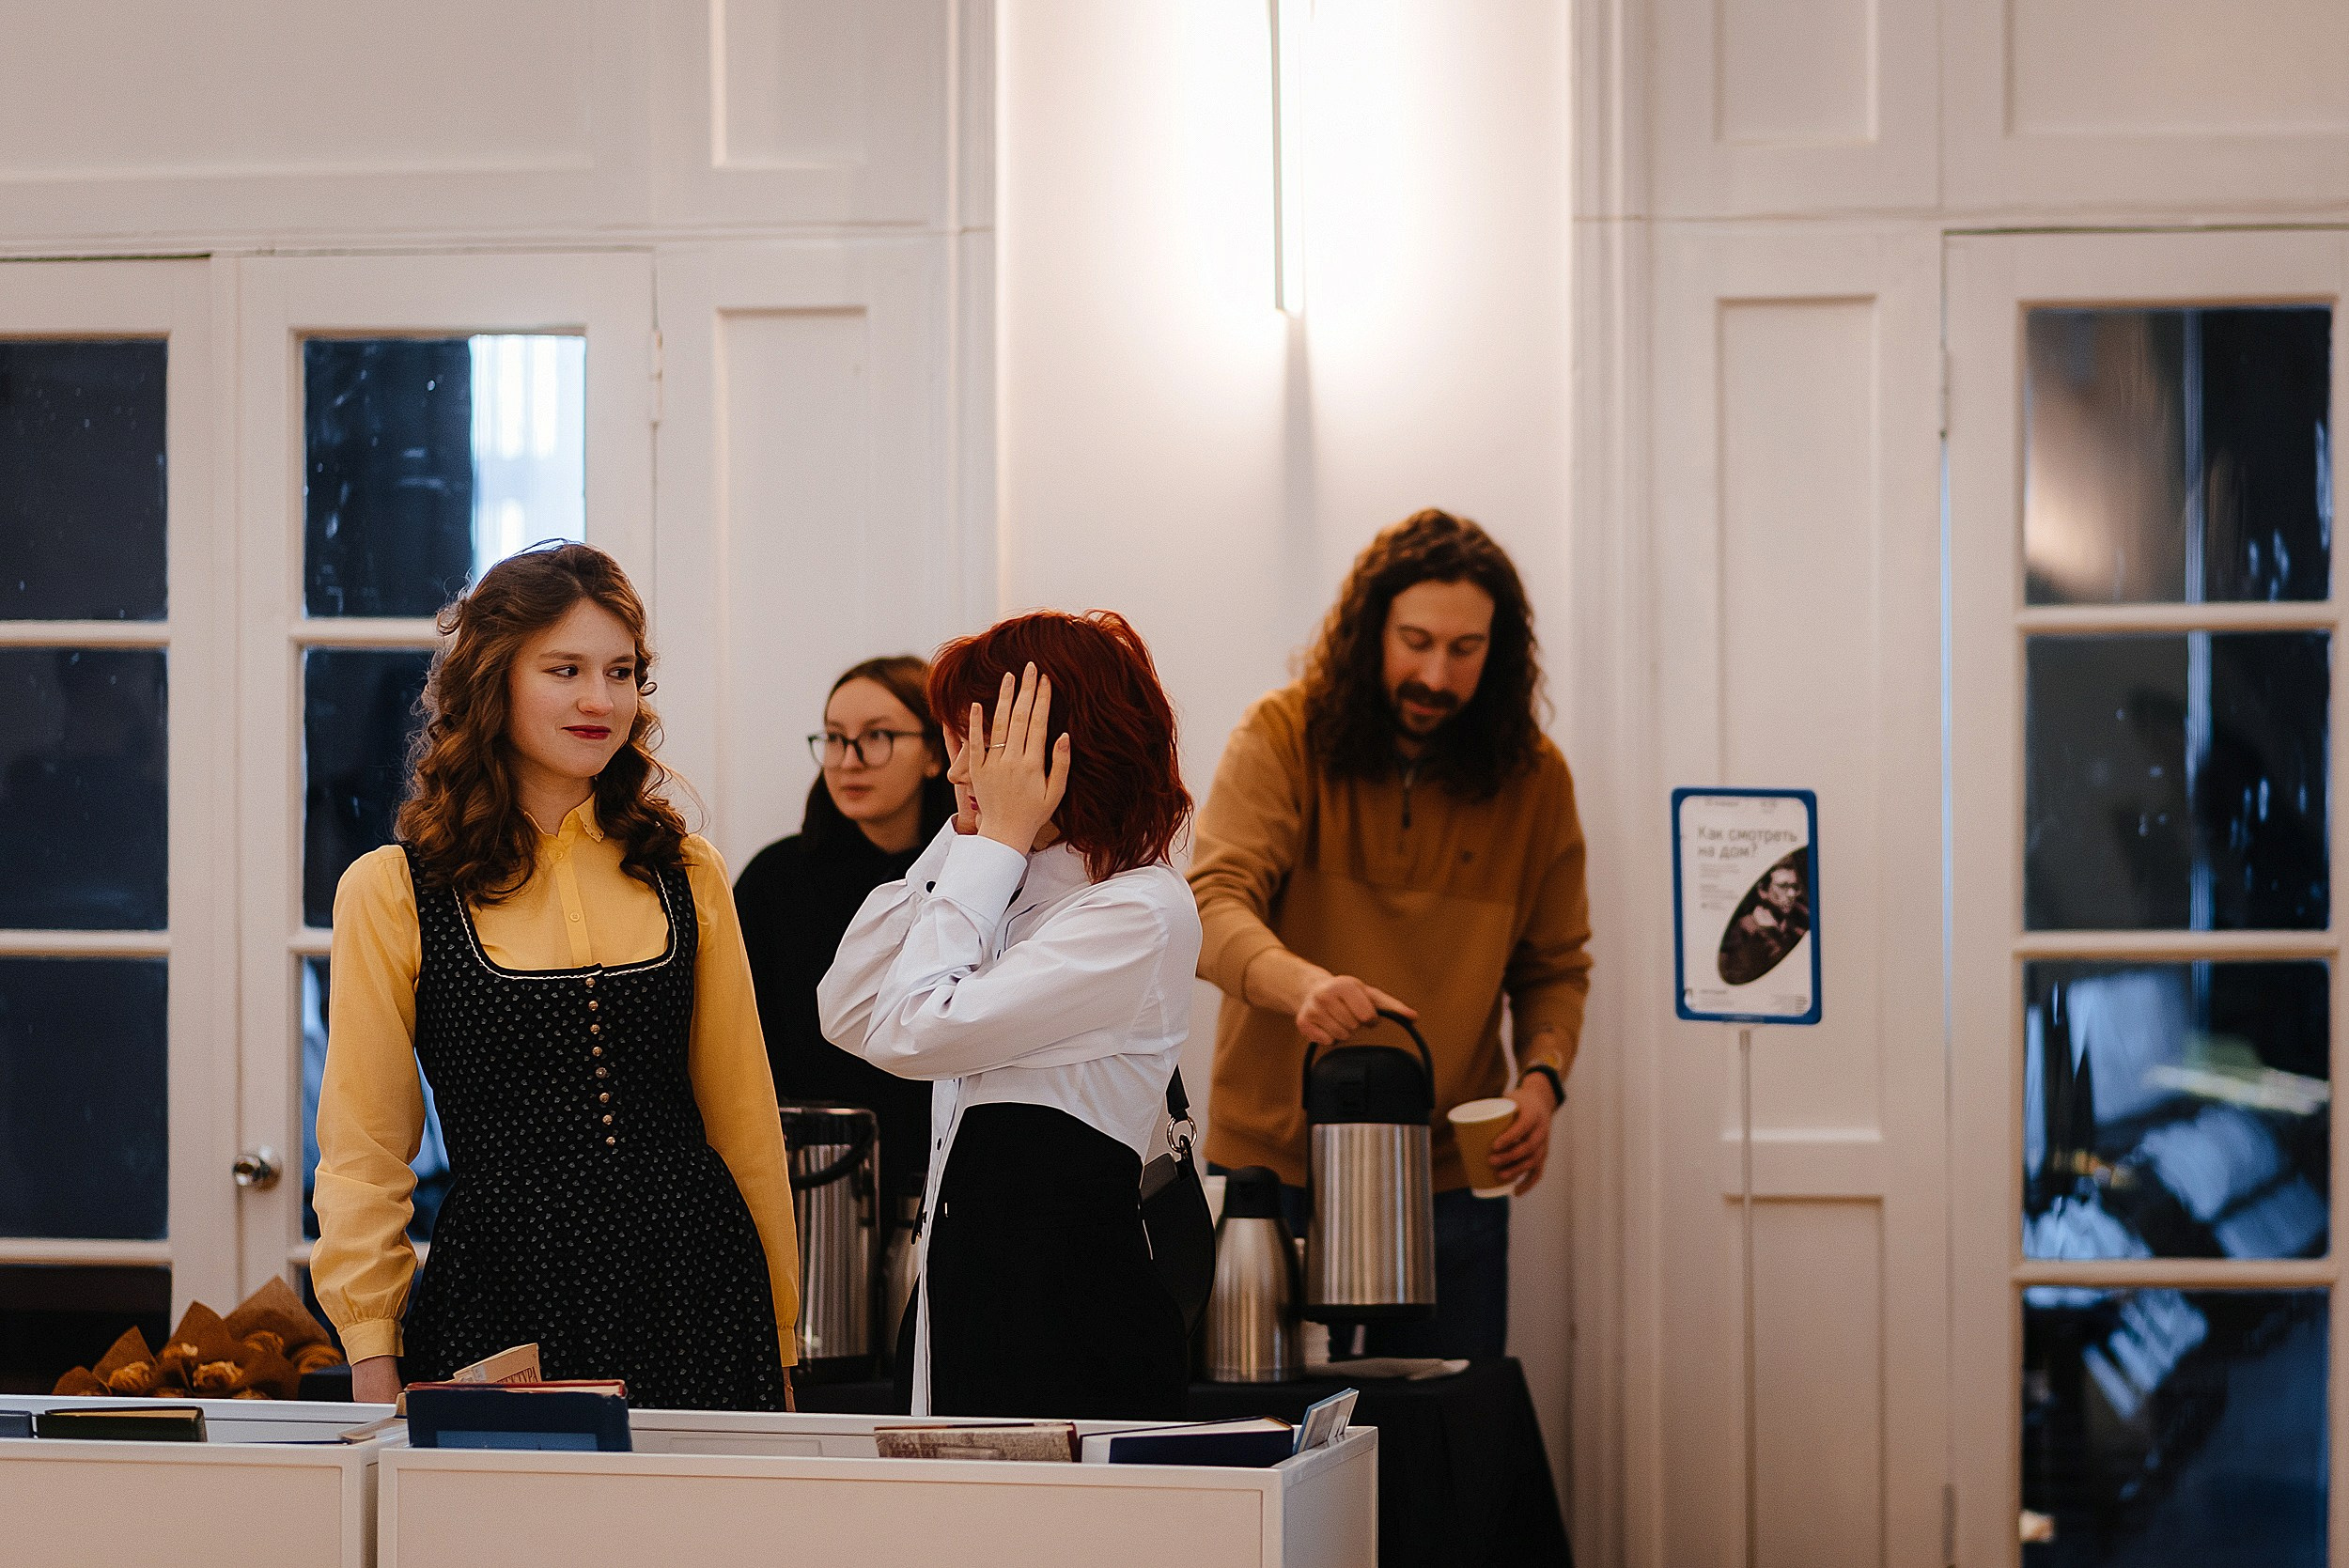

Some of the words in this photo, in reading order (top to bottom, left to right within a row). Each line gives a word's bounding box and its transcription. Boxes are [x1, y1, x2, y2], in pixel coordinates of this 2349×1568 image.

[1697, 827, 1722, 841] Как
[1729, 830, 1797, 844] смотреть
[1697, 846, 1714, 857] на
[1719, 845, 1757, 859] дом?
